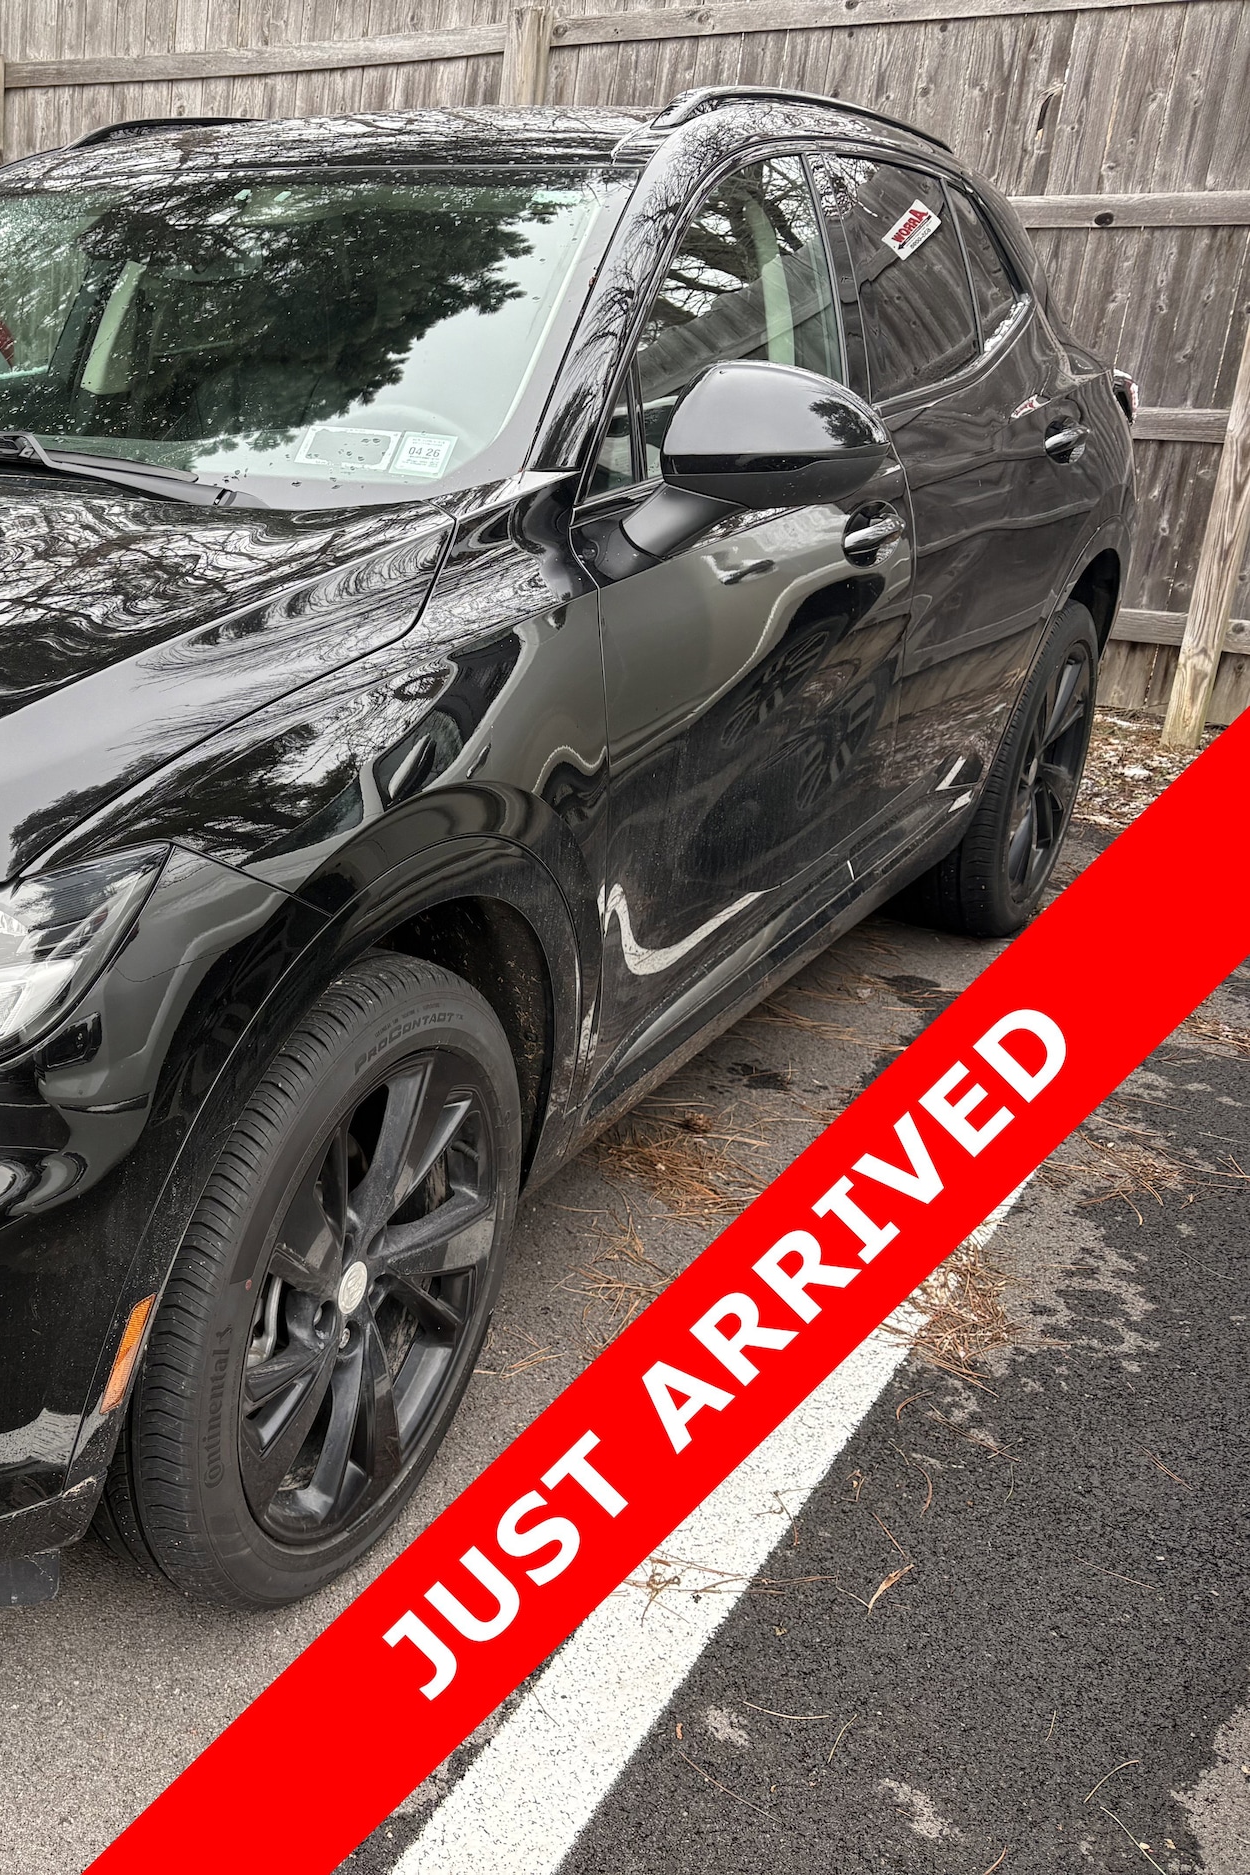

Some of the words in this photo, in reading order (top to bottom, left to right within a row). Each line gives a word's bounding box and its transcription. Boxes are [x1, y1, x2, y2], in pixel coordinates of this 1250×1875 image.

[408, 446, 423, 456] 04
[425, 447, 441, 458] 26
[203, 1348, 231, 1489] Continental
